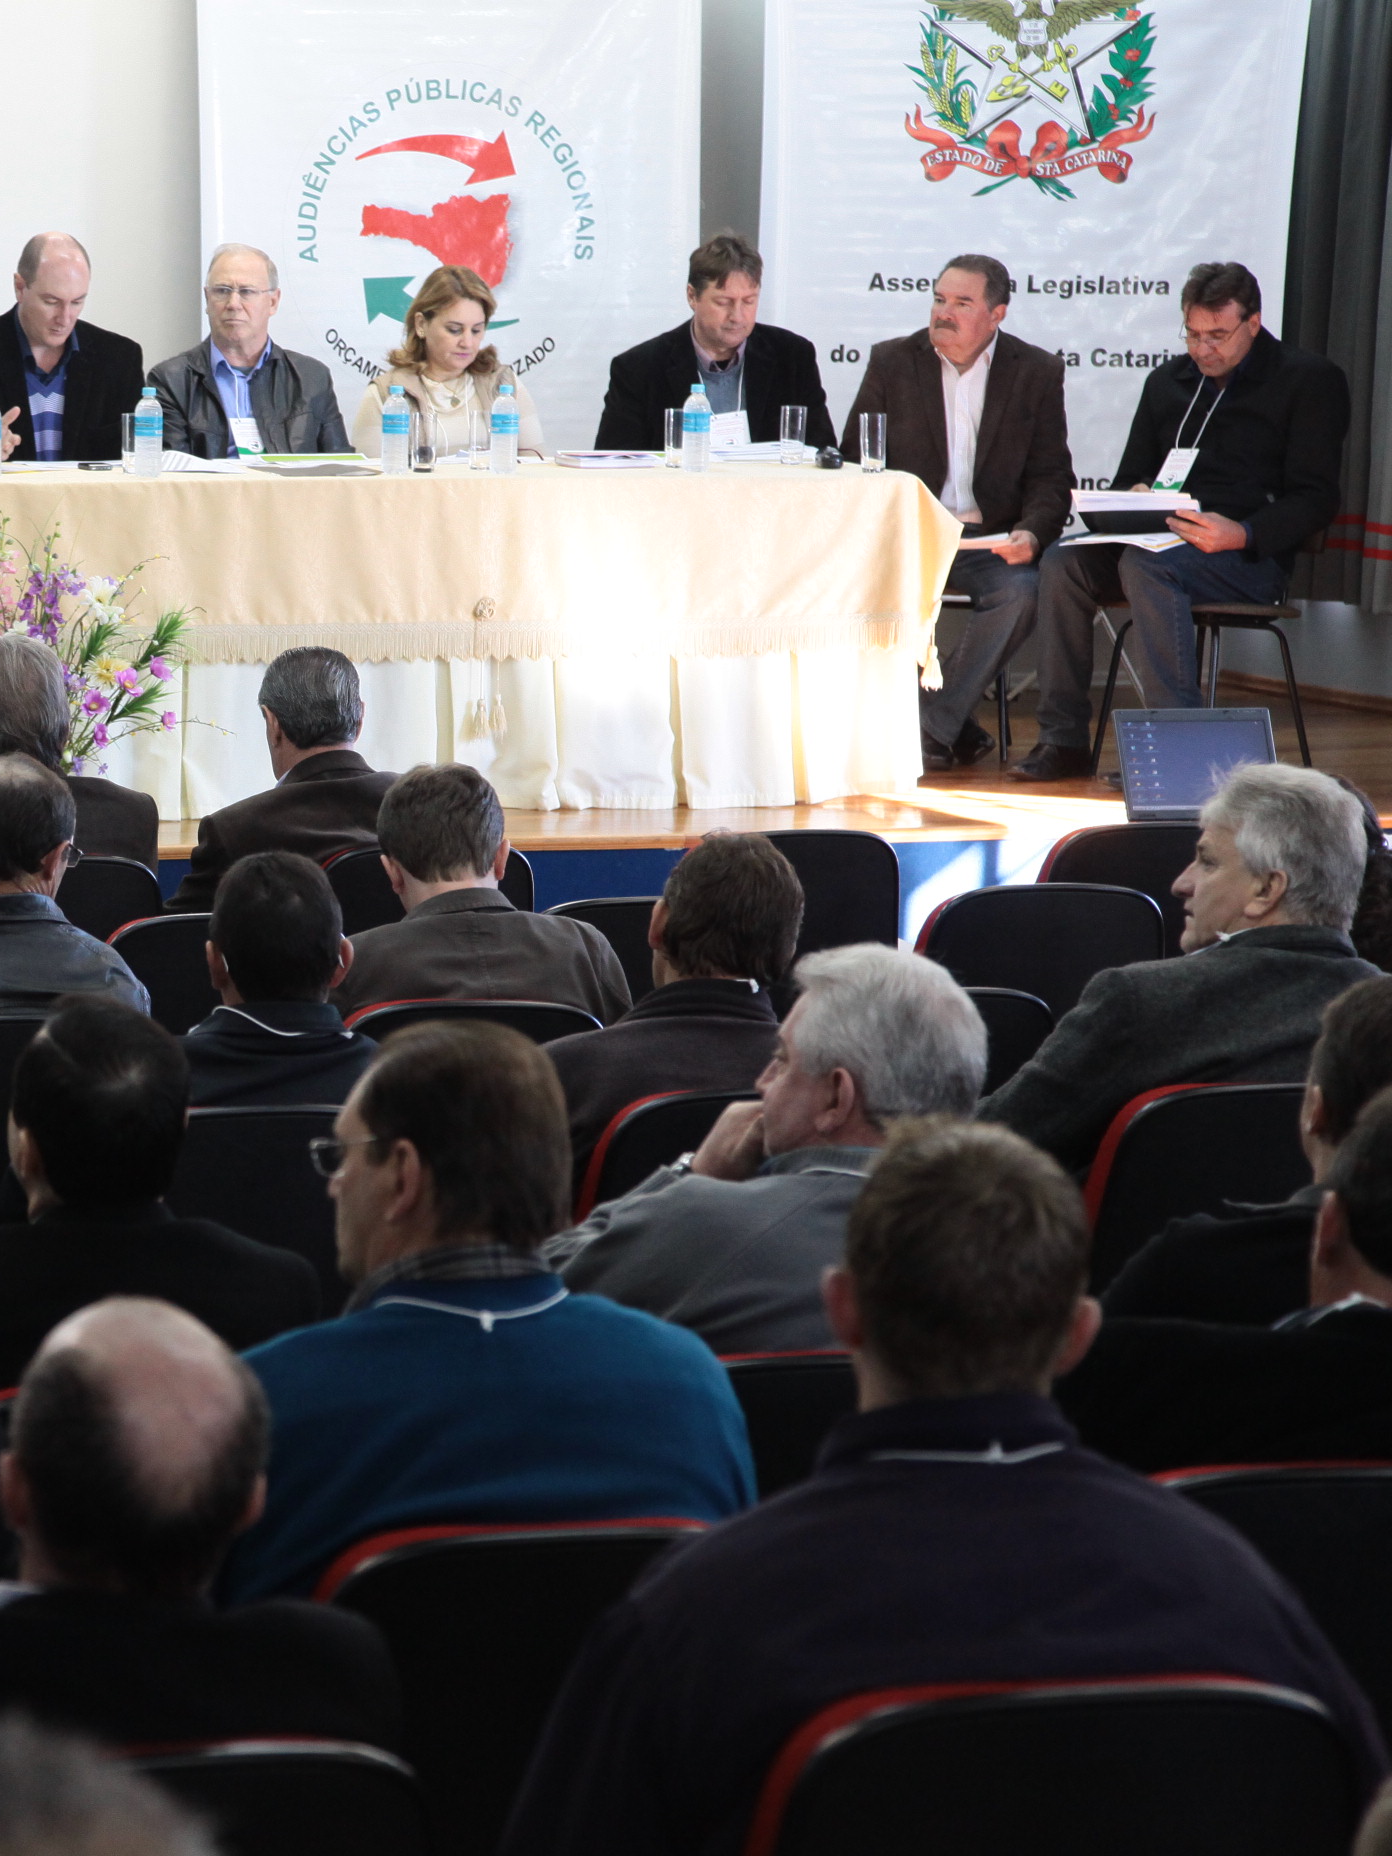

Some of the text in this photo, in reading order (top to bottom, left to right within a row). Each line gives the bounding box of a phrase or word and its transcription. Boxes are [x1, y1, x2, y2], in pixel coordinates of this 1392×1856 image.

[297, 77, 596, 263] AUDIÊNCIAS PÚBLICAS REGIONAIS
[926, 149, 1128, 177] ESTADO DE STA. CATARINA
[1027, 274, 1171, 299] Legislativa
[325, 328, 387, 383] ORÇAME
[830, 345, 861, 364] do
[1090, 347, 1185, 369] Catari
